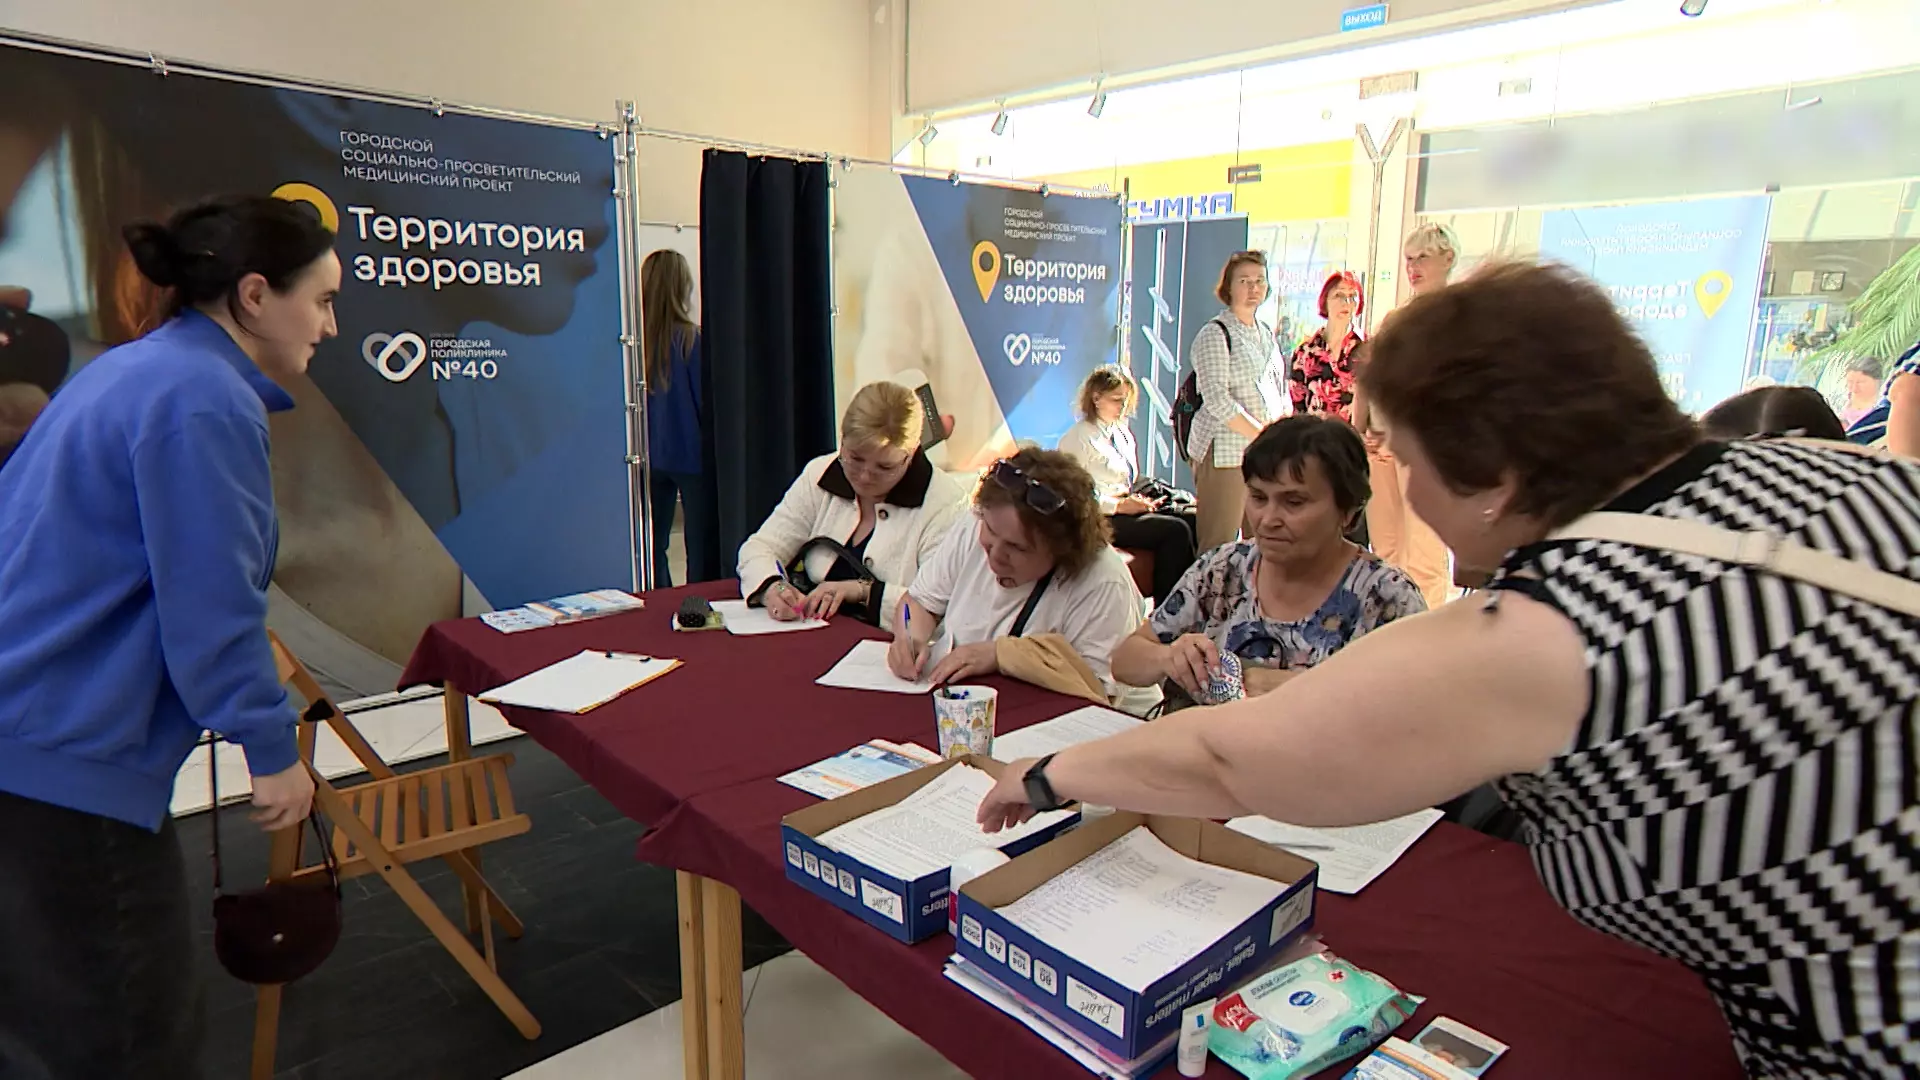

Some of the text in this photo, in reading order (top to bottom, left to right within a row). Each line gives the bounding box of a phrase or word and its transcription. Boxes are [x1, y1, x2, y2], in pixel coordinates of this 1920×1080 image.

[340, 131, 433, 153] ГОРОДСКОЙ
[341, 149, 581, 184] СОЦИАЛЬНО-ПРОСВЕТИТЕЛЬСКИЙ
[343, 165, 513, 192] МЕДИЦИНСКИЙ ПРОЕКТ
[348, 206, 585, 256] Территория
[354, 255, 541, 290] здоровья
[1004, 253, 1107, 284] Территория
[1004, 285, 1085, 307] здоровья
[430, 338, 492, 348] ГОРОДСКАЯ
[430, 348, 508, 358] ПОЛИКЛИНИКА
[1031, 351, 1061, 366] №40
[431, 359, 498, 381] №40
